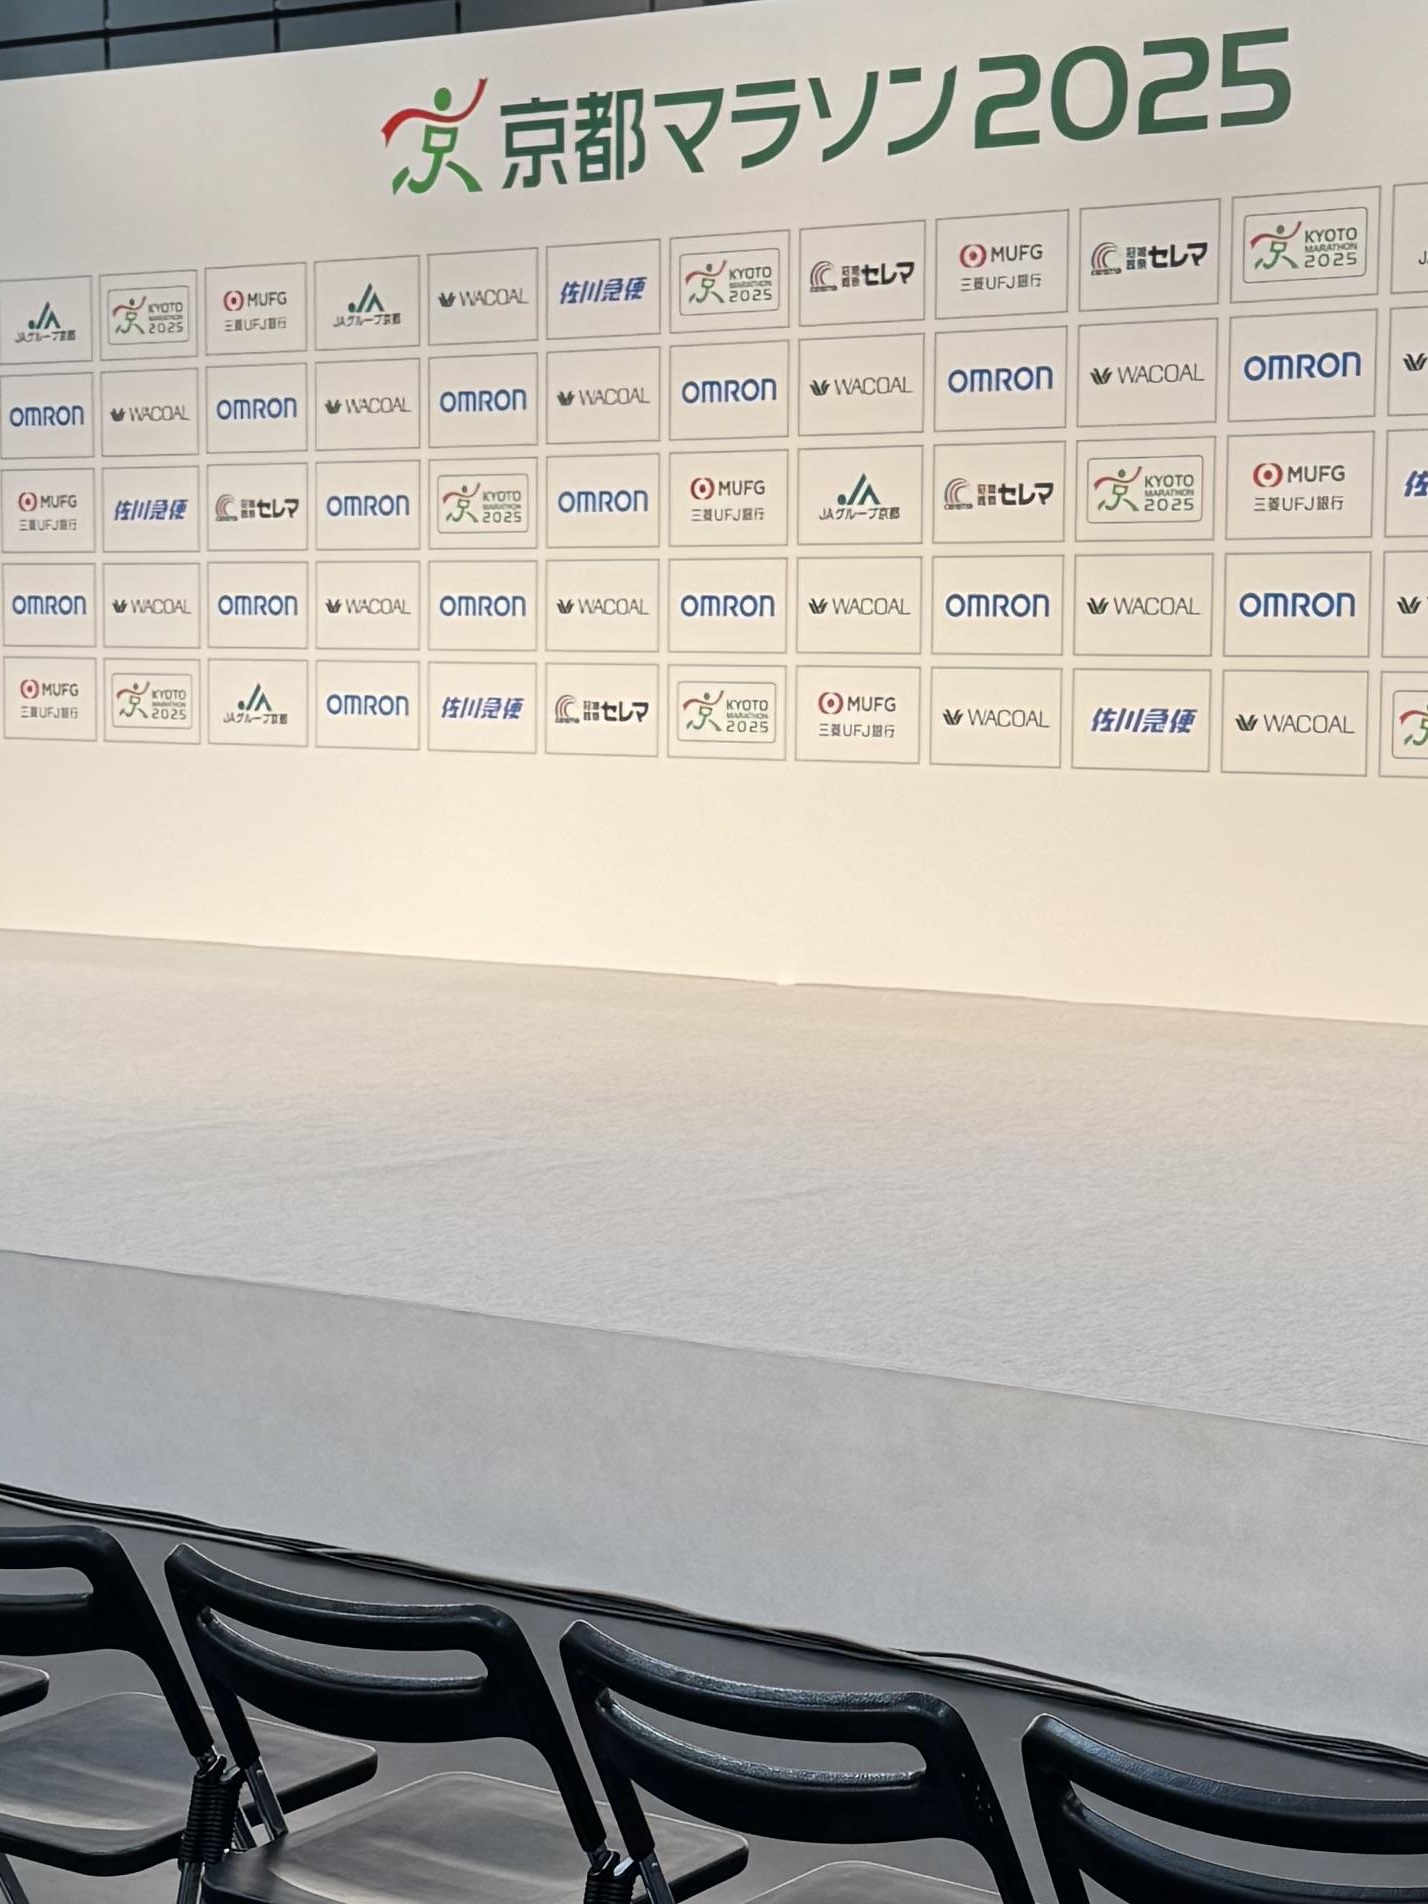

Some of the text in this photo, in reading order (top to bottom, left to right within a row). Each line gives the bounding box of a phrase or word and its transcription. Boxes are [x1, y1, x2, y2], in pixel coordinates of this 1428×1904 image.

[501, 27, 1292, 190] 京都マラソン2025
[1305, 227, 1357, 243] KYOTO
[991, 244, 1043, 262] MUFG
[1148, 242, 1208, 268] セレマ
[1305, 252, 1357, 268] 2025
[729, 267, 772, 280] KYOTO
[861, 262, 915, 286] セレマ
[247, 291, 287, 307] MUFG
[459, 288, 530, 307] WACOAL
[560, 277, 647, 304] 佐川急便
[729, 289, 772, 302] 2025
[148, 302, 183, 314] KYOTO
[148, 322, 183, 334] 2025
[1117, 363, 1206, 384] WACOAL
[1244, 352, 1361, 381] OMRON
[834, 376, 914, 396] WACOAL
[948, 366, 1053, 393] OMRON
[578, 387, 651, 406] WACOAL
[682, 378, 776, 403] OMRON
[217, 398, 297, 420] OMRON
[345, 397, 412, 414] WACOAL
[440, 389, 527, 413] OMRON
[9, 405, 84, 427] OMRON
[1145, 474, 1194, 488] KYOTO
[1288, 465, 1345, 483] MUFG
[482, 490, 521, 502] KYOTO
[718, 480, 765, 496] MUFG
[998, 483, 1054, 505] セレマ
[40, 495, 77, 508] MUFG
[114, 499, 188, 520] 佐川急便
[254, 499, 299, 518] セレマ
[327, 495, 409, 516] OMRON
[558, 490, 648, 513] OMRON
[1144, 498, 1194, 511] 2025
[482, 511, 521, 523] 2025
[12, 595, 86, 615] OMRON
[218, 595, 298, 616] OMRON
[345, 598, 411, 615] WACOAL
[440, 595, 526, 616] OMRON
[578, 598, 650, 615] WACOAL
[681, 595, 774, 617] OMRON
[832, 597, 911, 615] WACOAL
[946, 594, 1049, 617] OMRON
[1113, 596, 1201, 616] WACOAL
[1240, 592, 1355, 617] OMRON
[42, 683, 79, 696] MUFG
[152, 689, 186, 700] KYOTO
[327, 694, 409, 716] OMRON
[441, 697, 524, 719] 佐川急便
[601, 701, 649, 722] セレマ
[726, 699, 768, 711] KYOTO
[848, 696, 896, 712] MUFG
[152, 708, 186, 720] 2025
[967, 709, 1050, 728] WACOAL
[1091, 708, 1198, 733] 佐川急便
[726, 720, 768, 733] 2025
[1263, 714, 1356, 734] WACOAL
